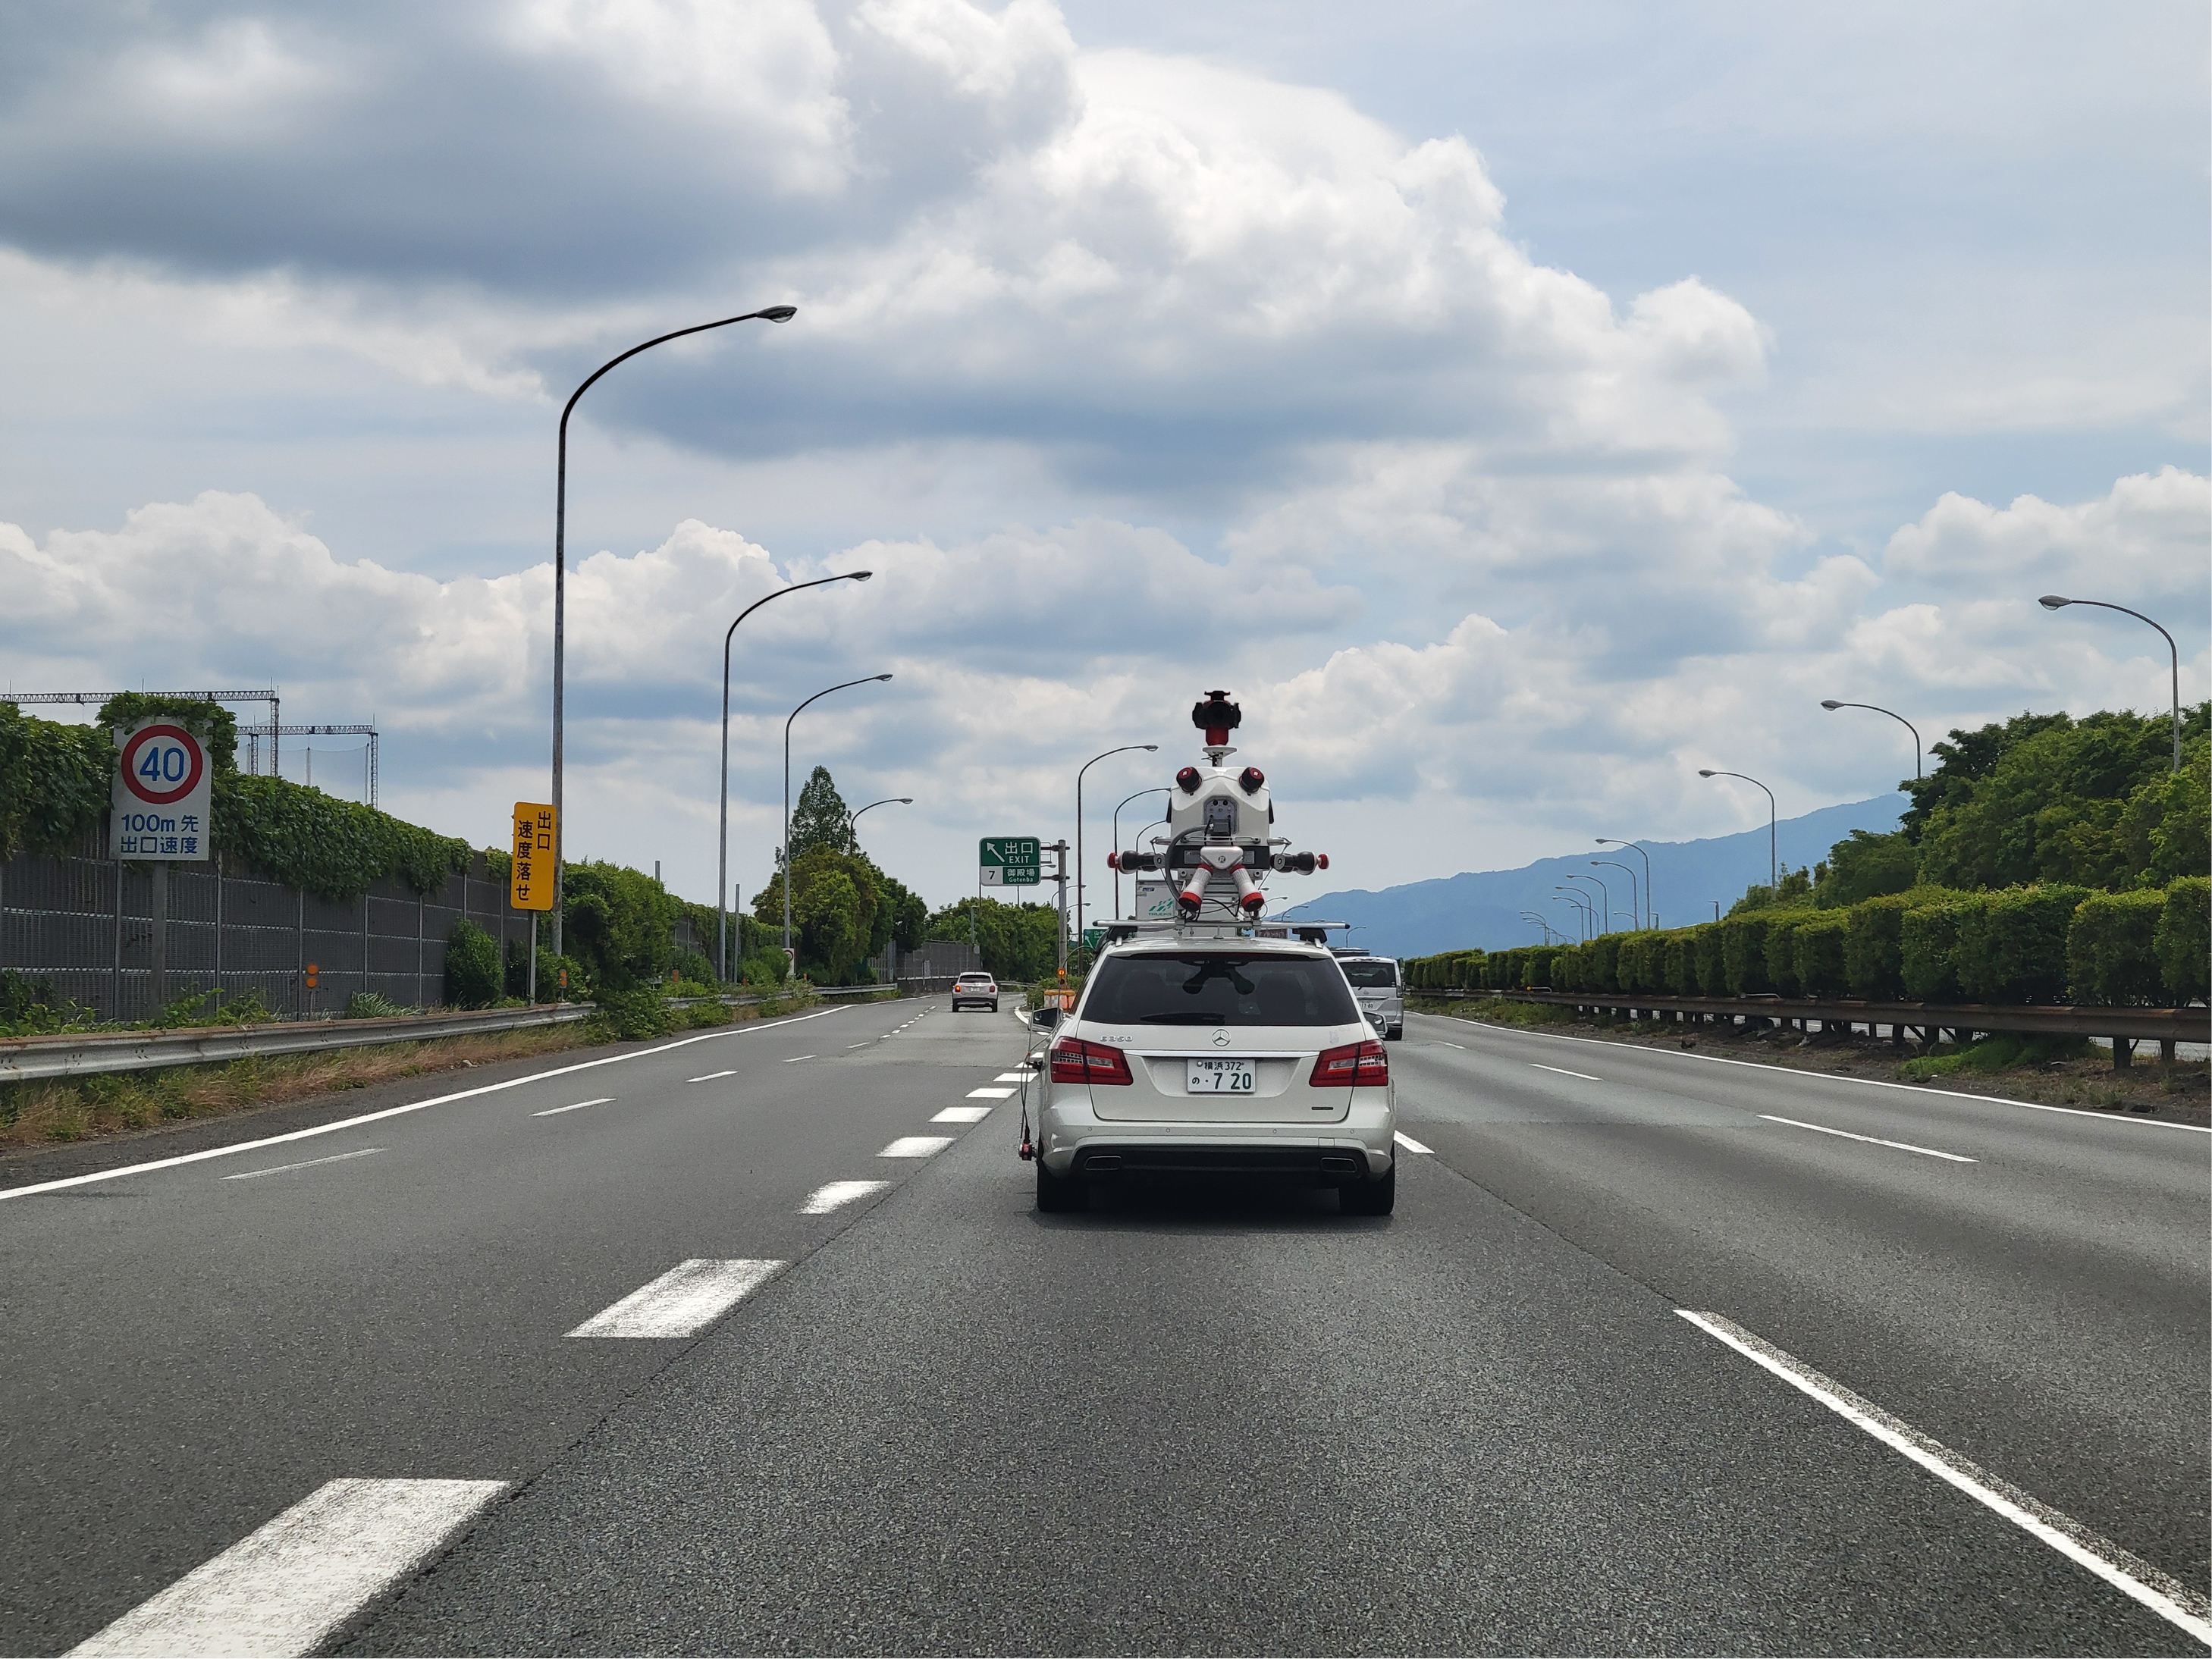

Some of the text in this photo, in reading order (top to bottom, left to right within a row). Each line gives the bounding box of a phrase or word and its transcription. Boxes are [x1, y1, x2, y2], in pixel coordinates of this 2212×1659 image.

[140, 747, 184, 782] 40
[537, 811, 551, 851] 出口
[121, 836, 198, 854] 出口速度
[1005, 842, 1034, 855] 出口
[516, 820, 533, 901] 速度落せ
[1009, 855, 1030, 864] EXIT
[988, 870, 996, 880] 7
[1007, 868, 1035, 877] 御殿場
